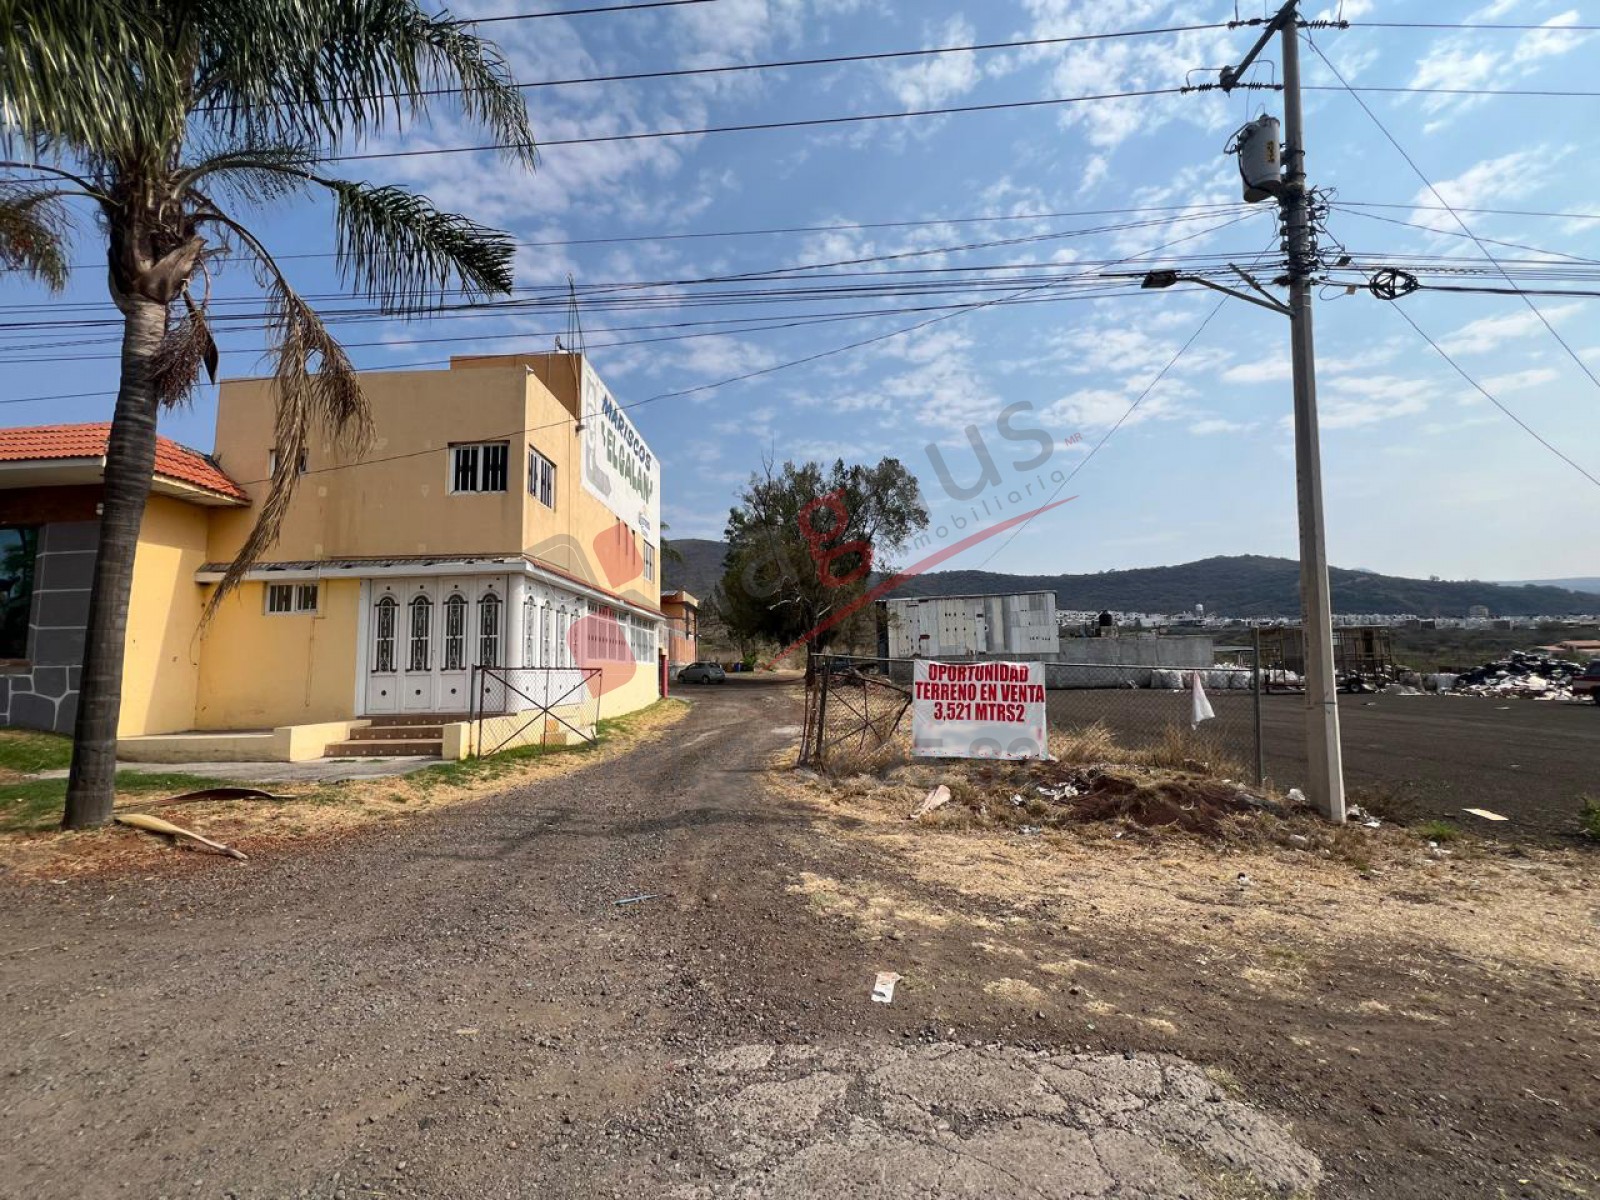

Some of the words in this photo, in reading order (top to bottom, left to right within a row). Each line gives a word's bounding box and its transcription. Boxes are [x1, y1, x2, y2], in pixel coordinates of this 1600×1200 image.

[602, 393, 652, 472] MARISCOS
[928, 664, 1029, 682] OPORTUNIDAD
[915, 681, 977, 701] TERRENO
[980, 683, 998, 701] EN
[1001, 684, 1046, 703] VENTA
[934, 702, 972, 722] 3,521
[975, 703, 1025, 722] MTRS2
